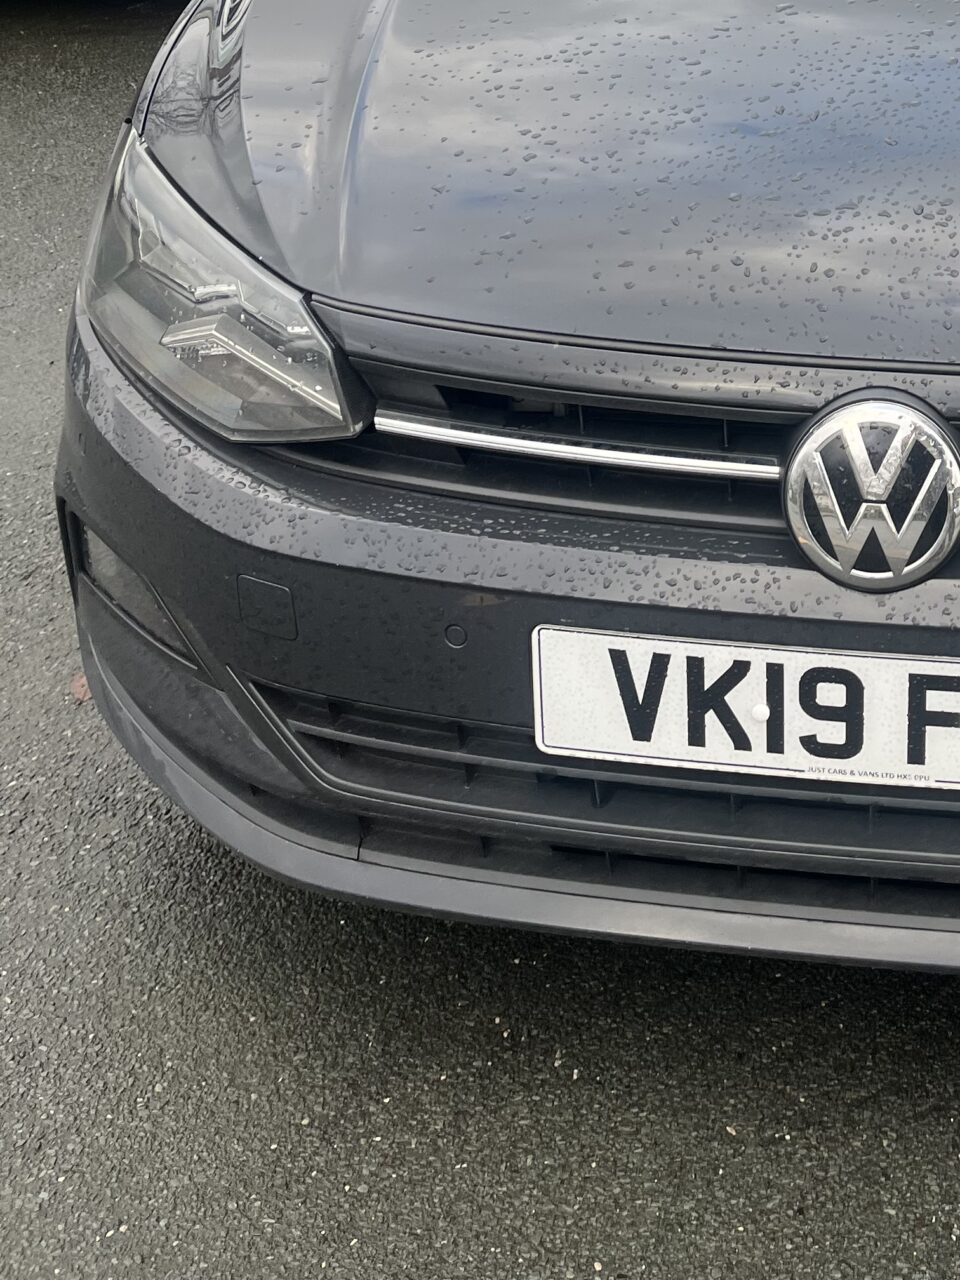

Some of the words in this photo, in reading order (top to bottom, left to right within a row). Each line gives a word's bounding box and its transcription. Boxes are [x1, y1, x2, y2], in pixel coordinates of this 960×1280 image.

[607, 647, 866, 760] VK19
[807, 766, 825, 774] JUST
[827, 767, 847, 775] CARS
[858, 769, 880, 778] VANS
[881, 771, 894, 779] LTD
